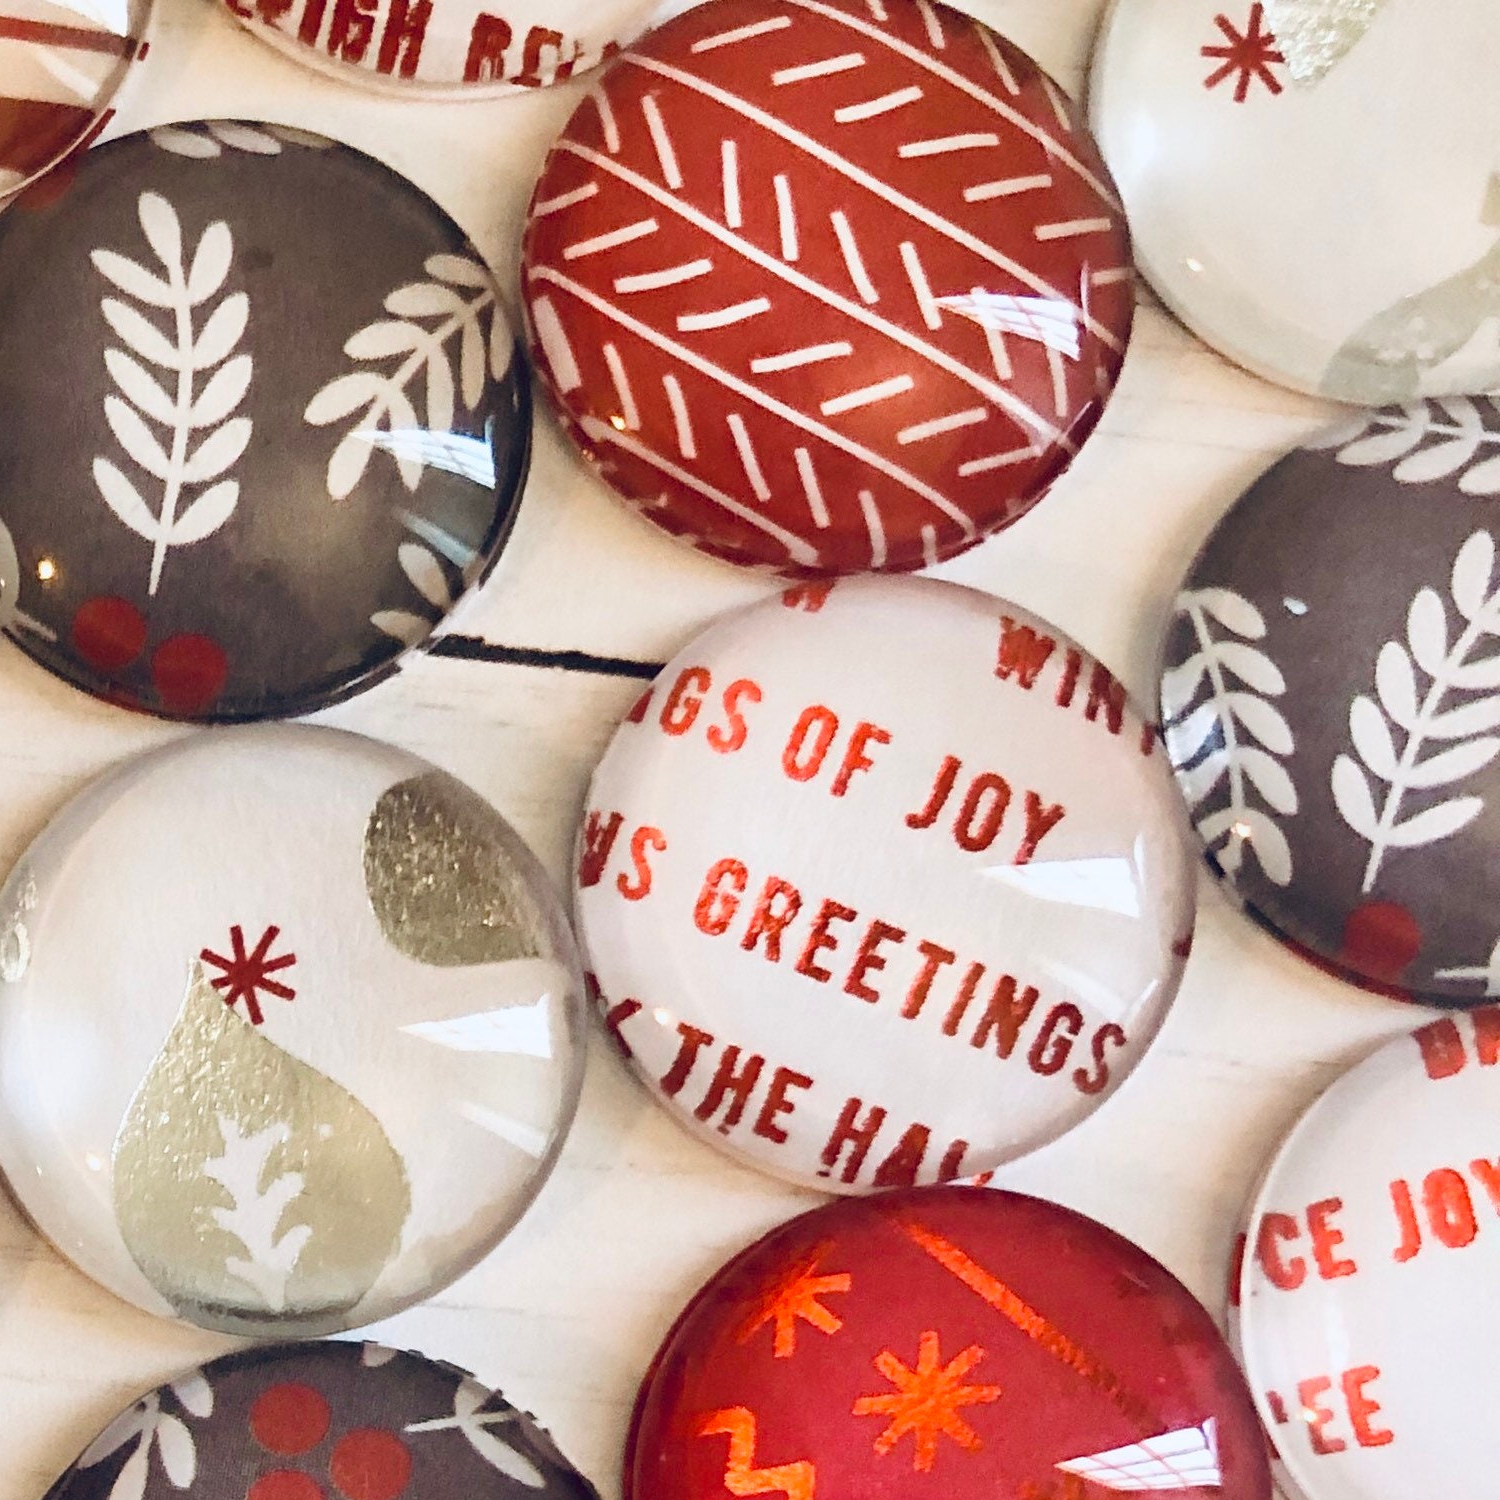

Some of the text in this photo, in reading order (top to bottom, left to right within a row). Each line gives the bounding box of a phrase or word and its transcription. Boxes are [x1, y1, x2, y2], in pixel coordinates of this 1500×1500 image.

[626, 666, 1065, 866] GS OF JOY
[692, 858, 1127, 1095] GREETINGS
[660, 1022, 814, 1145] THE
[1229, 1198, 1358, 1308] CE
